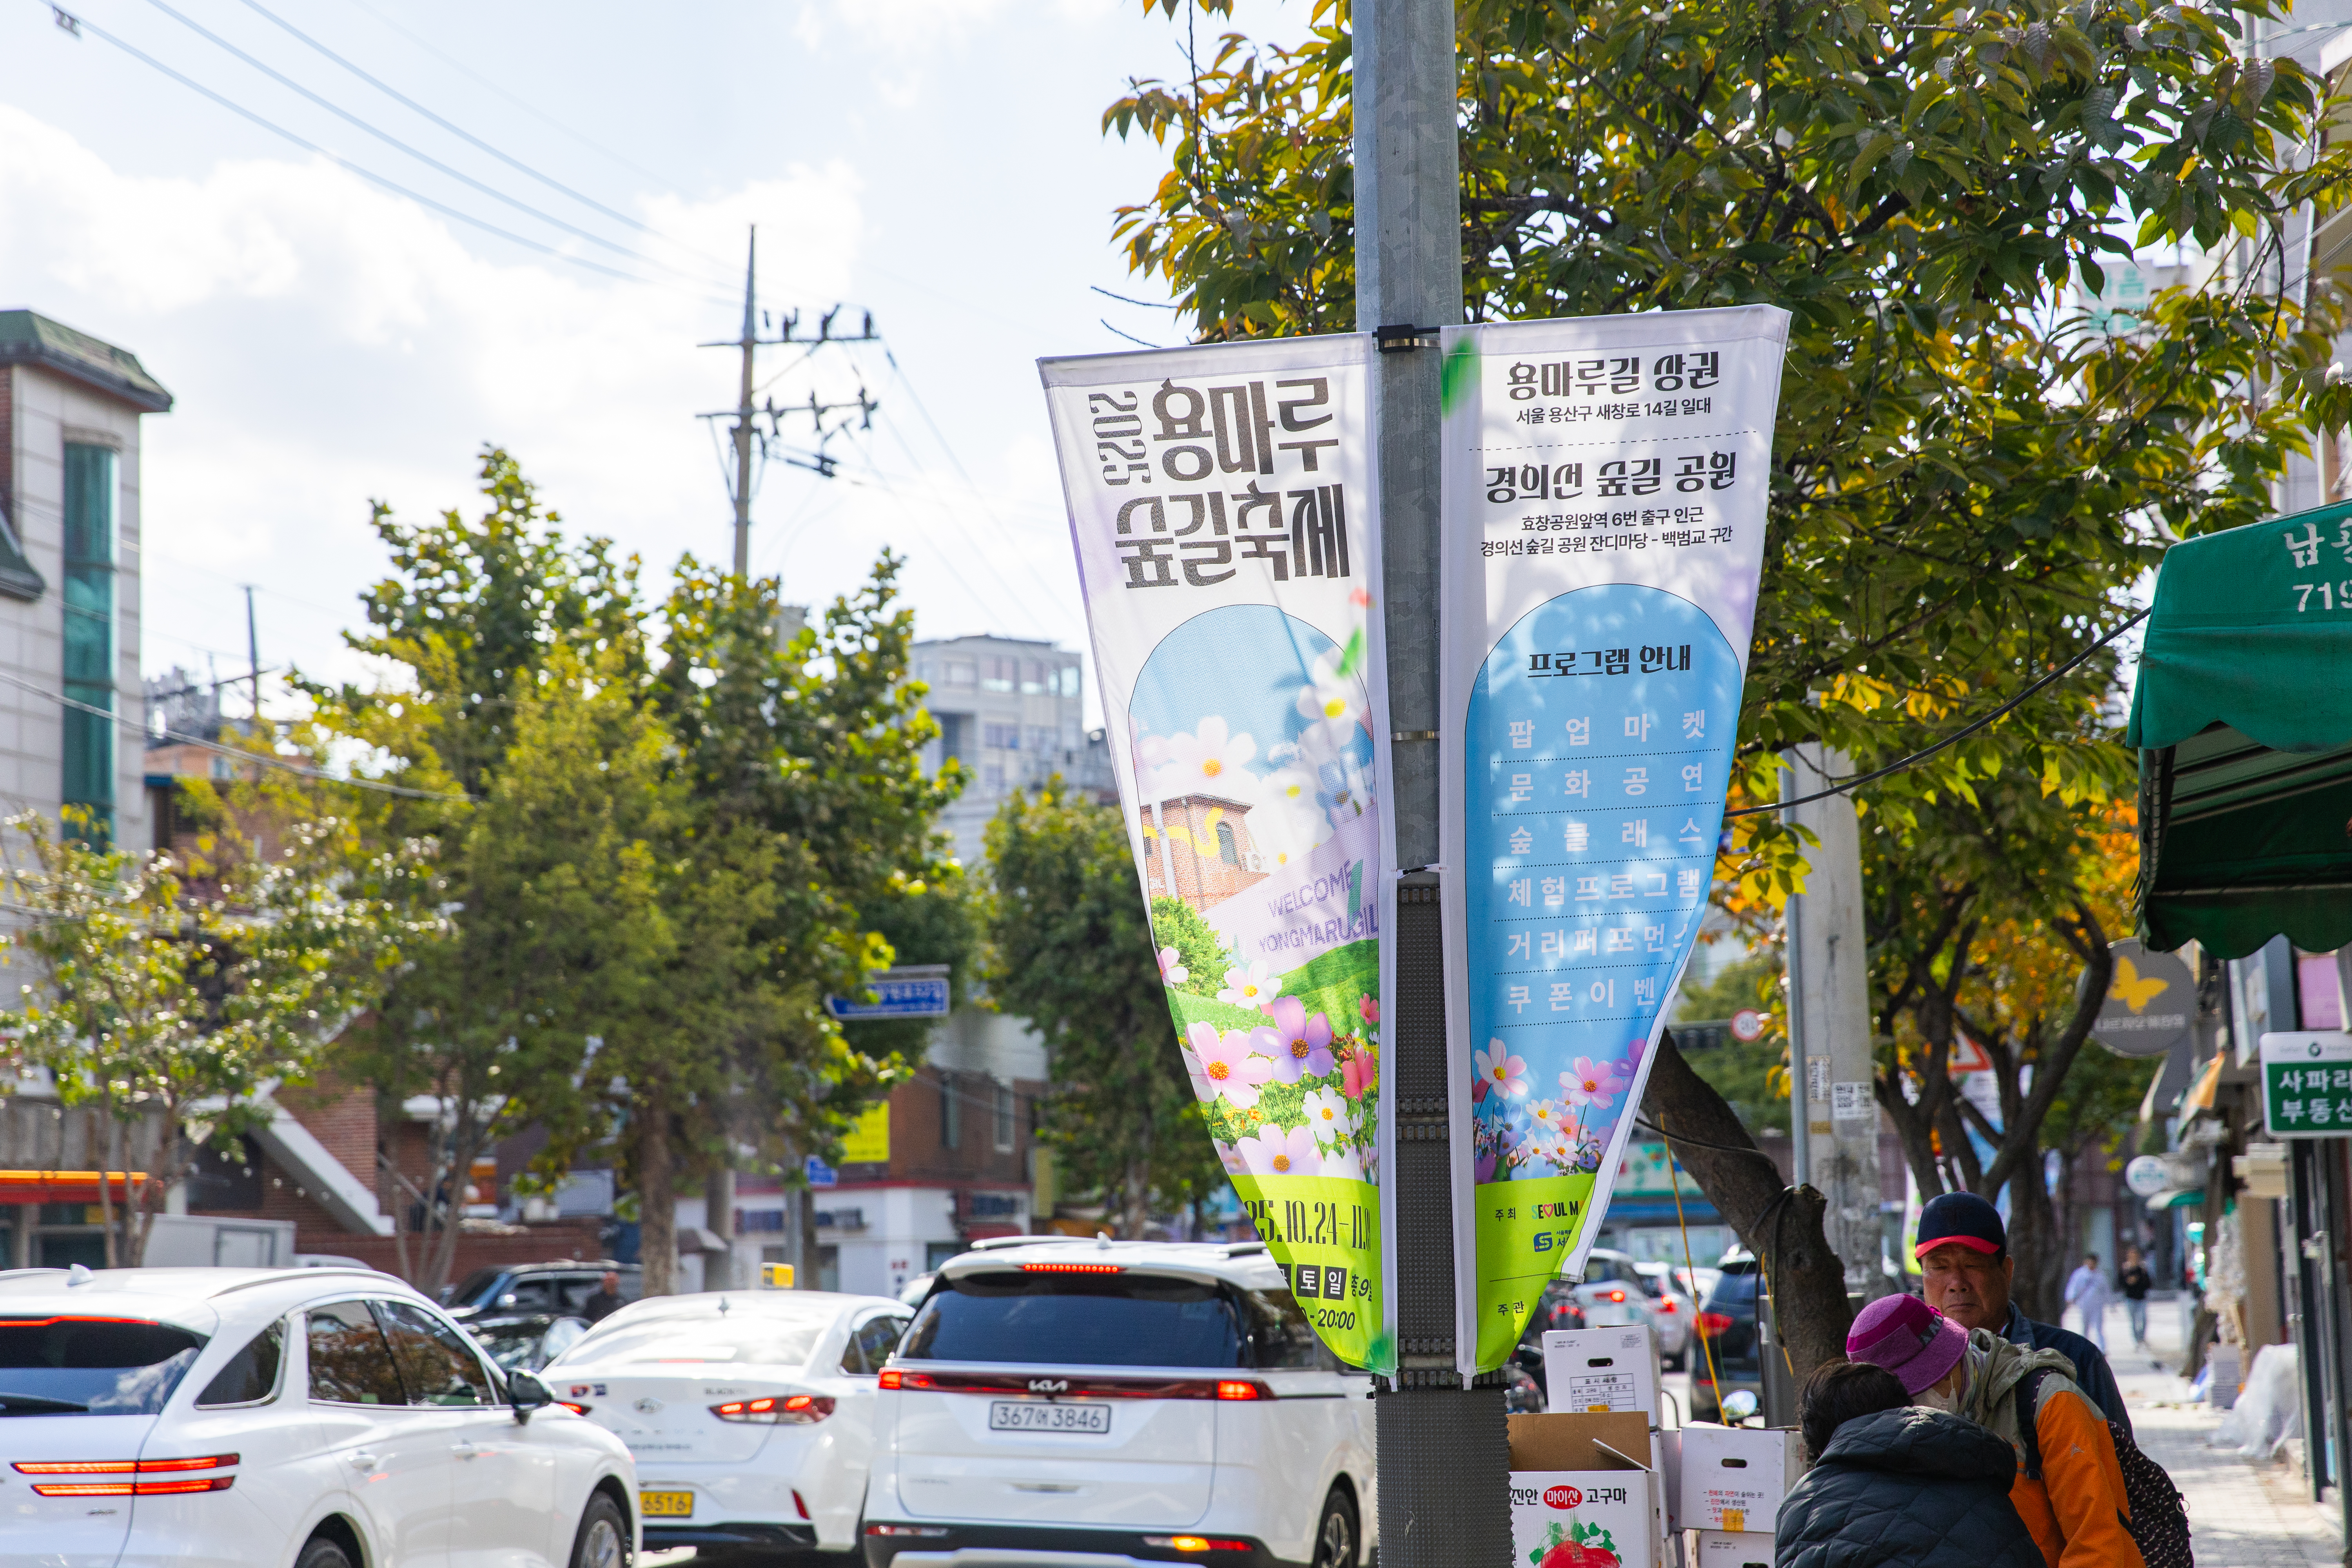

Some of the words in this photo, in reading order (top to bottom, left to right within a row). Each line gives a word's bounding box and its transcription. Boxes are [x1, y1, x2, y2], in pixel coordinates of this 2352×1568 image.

[1507, 357, 1639, 400] 용마루길
[1654, 352, 1719, 391] 상권
[1153, 377, 1339, 483] 용마루
[1517, 408, 1545, 424] 서울
[1549, 406, 1592, 423] 용산구
[1597, 403, 1640, 420] 새창로
[1645, 399, 1677, 416] 14길
[1682, 397, 1710, 415] 일대
[1089, 391, 1151, 485] 2025
[1486, 463, 1582, 503] 경의선
[1597, 458, 1661, 497] 숲길
[1675, 451, 1736, 492] 공원
[1114, 477, 1350, 588] 숲길축제
[1522, 512, 1607, 531] 효창공원앞역
[1612, 510, 1636, 526] 6번
[1641, 509, 1670, 525] 출구
[1674, 507, 1704, 523] 인근
[1481, 539, 1523, 557] 경의선
[1526, 538, 1553, 554] 숲길
[1558, 536, 1585, 553] 공원
[1590, 533, 1648, 551] 잔디마당
[1662, 530, 1706, 547] 백범교
[1710, 526, 1733, 543] 구간
[1528, 648, 1629, 677] 프로그램
[1640, 645, 1690, 673] 안내
[1268, 860, 1354, 918] WELCOME
[1318, 1309, 1355, 1330] 20:00
[1512, 1489, 1538, 1505] 진안
[1547, 1490, 1579, 1505] 마이산
[1587, 1488, 1626, 1504] 고구마
